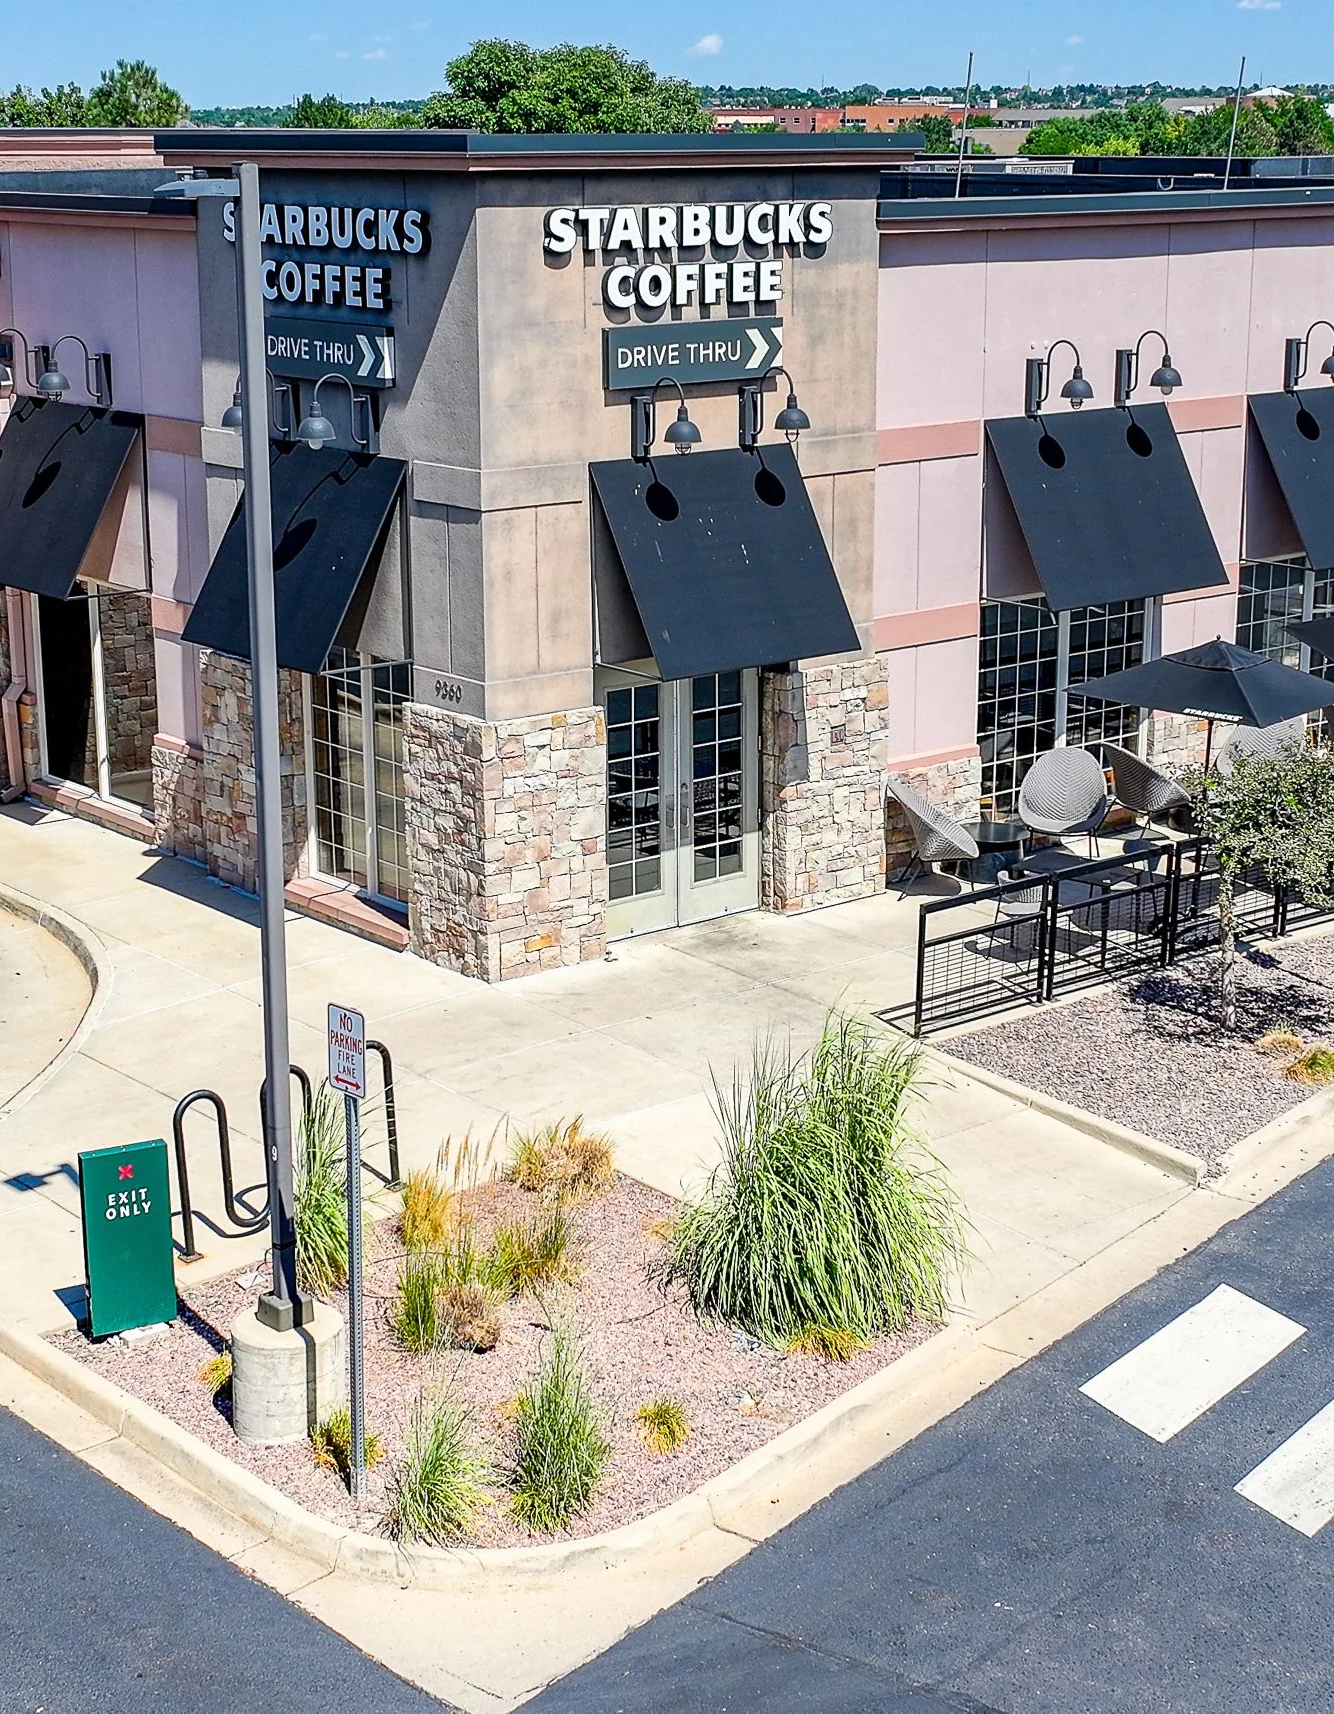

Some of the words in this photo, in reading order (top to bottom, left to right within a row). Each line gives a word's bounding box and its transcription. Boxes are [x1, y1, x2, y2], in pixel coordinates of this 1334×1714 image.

[223, 202, 423, 254] SARBUCKS
[544, 202, 833, 252] STARBUCKS
[261, 260, 384, 309] COFFEE
[607, 260, 783, 308] COFFEE
[267, 335, 310, 360] DRIVE
[313, 340, 354, 365] THRU
[617, 345, 680, 370] DRIVE
[686, 339, 742, 364] THRU
[435, 680, 462, 704] 9360
[339, 1012, 353, 1033] NO
[330, 1029, 363, 1056] PARKING
[337, 1062, 356, 1079] LANE
[338, 1050, 356, 1066] FIRE
[271, 1145, 278, 1161] 9
[108, 1188, 148, 1206] EXIT
[105, 1201, 151, 1220] ONLY
